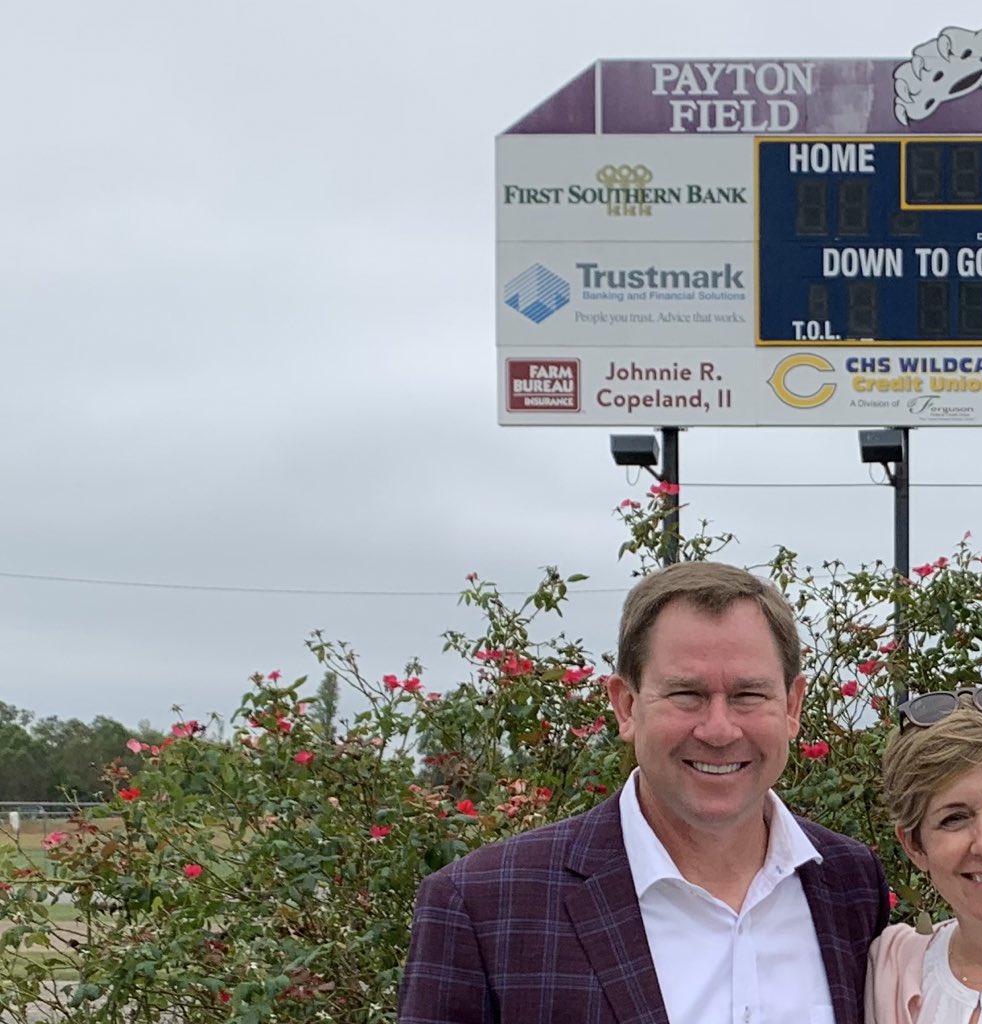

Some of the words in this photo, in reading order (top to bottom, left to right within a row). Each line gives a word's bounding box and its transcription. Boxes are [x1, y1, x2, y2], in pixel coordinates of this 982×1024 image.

[652, 62, 815, 95] PAYTON
[669, 100, 799, 132] FIELD
[789, 143, 875, 173] HOME
[503, 184, 563, 204] FIRST
[568, 184, 681, 204] SOUTHERN
[686, 184, 747, 204] BANK
[823, 248, 903, 277] DOWN
[915, 248, 949, 277] TO
[575, 263, 744, 289] Trustmark
[583, 291, 625, 302] Banking
[627, 291, 646, 300] and
[650, 291, 695, 300] Financial
[698, 291, 746, 300] Solutions
[575, 311, 607, 325] People
[607, 314, 628, 325] you
[657, 311, 690, 322] Advice
[692, 311, 712, 322] that
[792, 320, 841, 341] T.O.L.
[529, 364, 573, 379] FARM
[605, 362, 692, 381] Johnnie
[700, 362, 722, 381] R.
[846, 357, 891, 373] CHS
[513, 379, 574, 393] BUREAU
[852, 375, 923, 393] Credit
[524, 397, 574, 407] INSURANCE
[596, 389, 710, 413] Copeland,
[858, 399, 889, 407] Division
[891, 399, 900, 407] of
